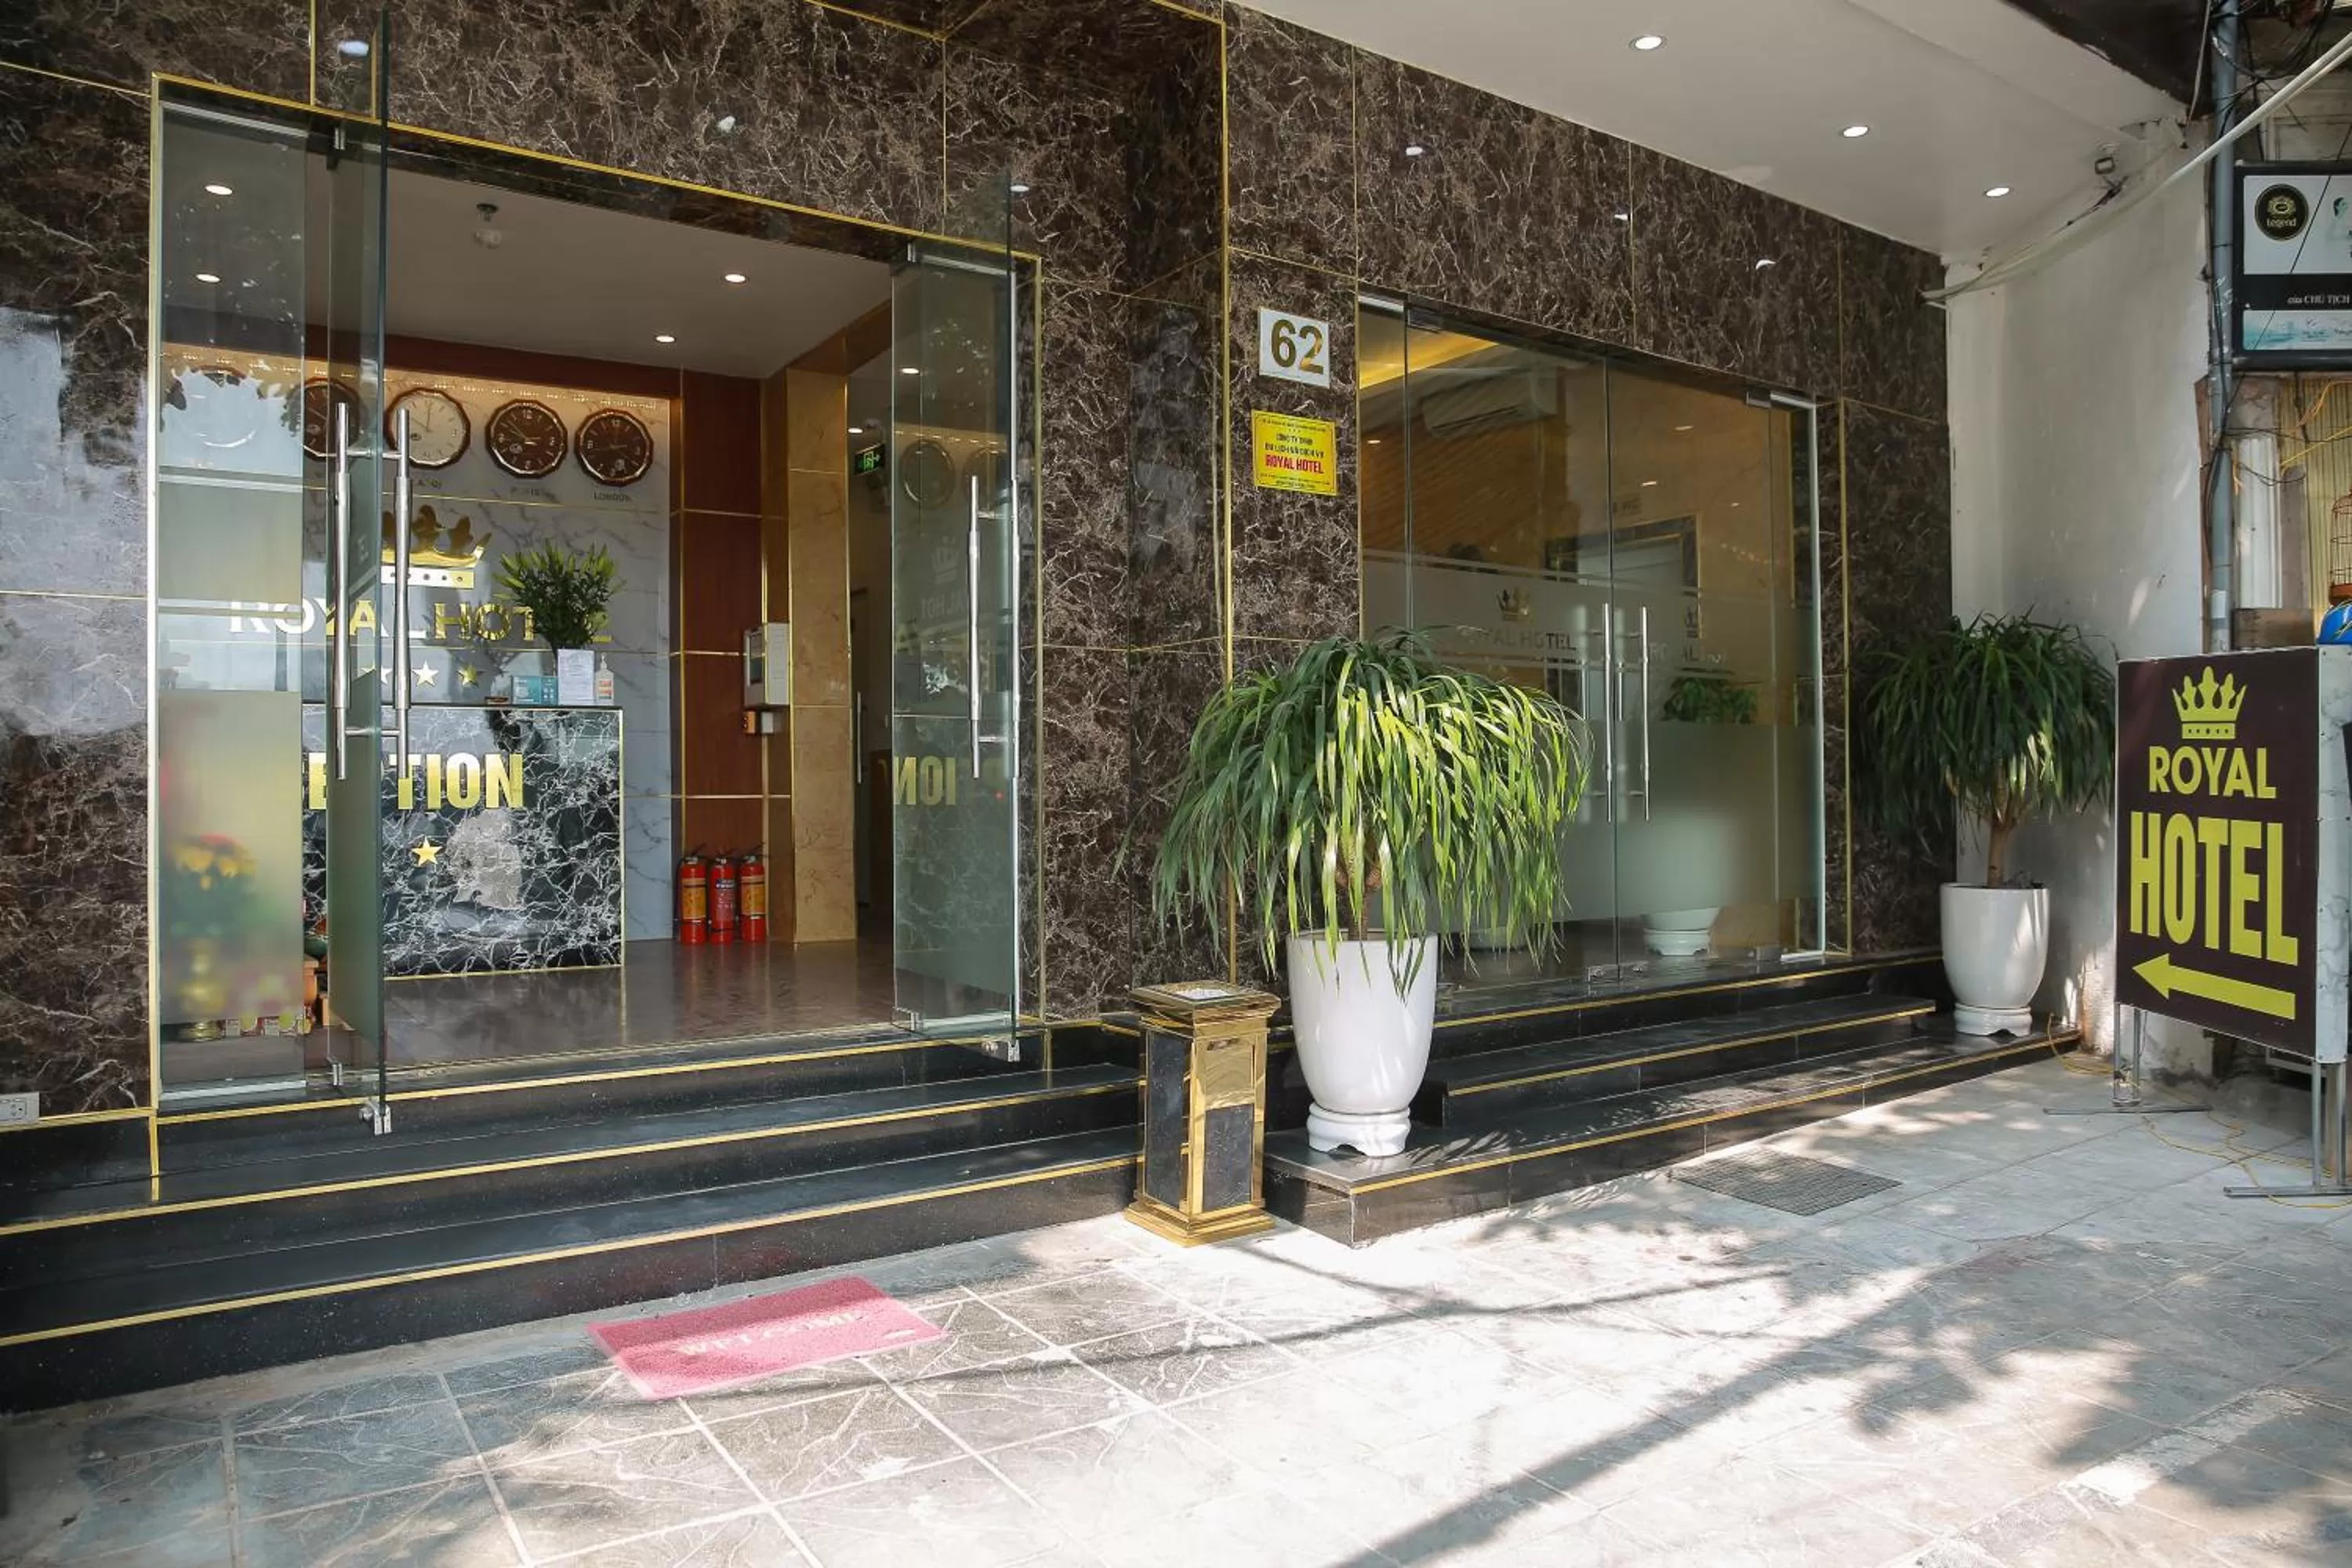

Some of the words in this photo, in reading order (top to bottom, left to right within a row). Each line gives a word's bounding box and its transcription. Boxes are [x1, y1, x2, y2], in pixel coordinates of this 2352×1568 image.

[2267, 218, 2296, 228] Legend
[1271, 319, 1324, 375] 62
[1265, 454, 1295, 470] ROYAL
[1296, 458, 1325, 474] HOTEL
[2148, 745, 2277, 799] ROYAL
[2129, 811, 2299, 967] HOTEL
